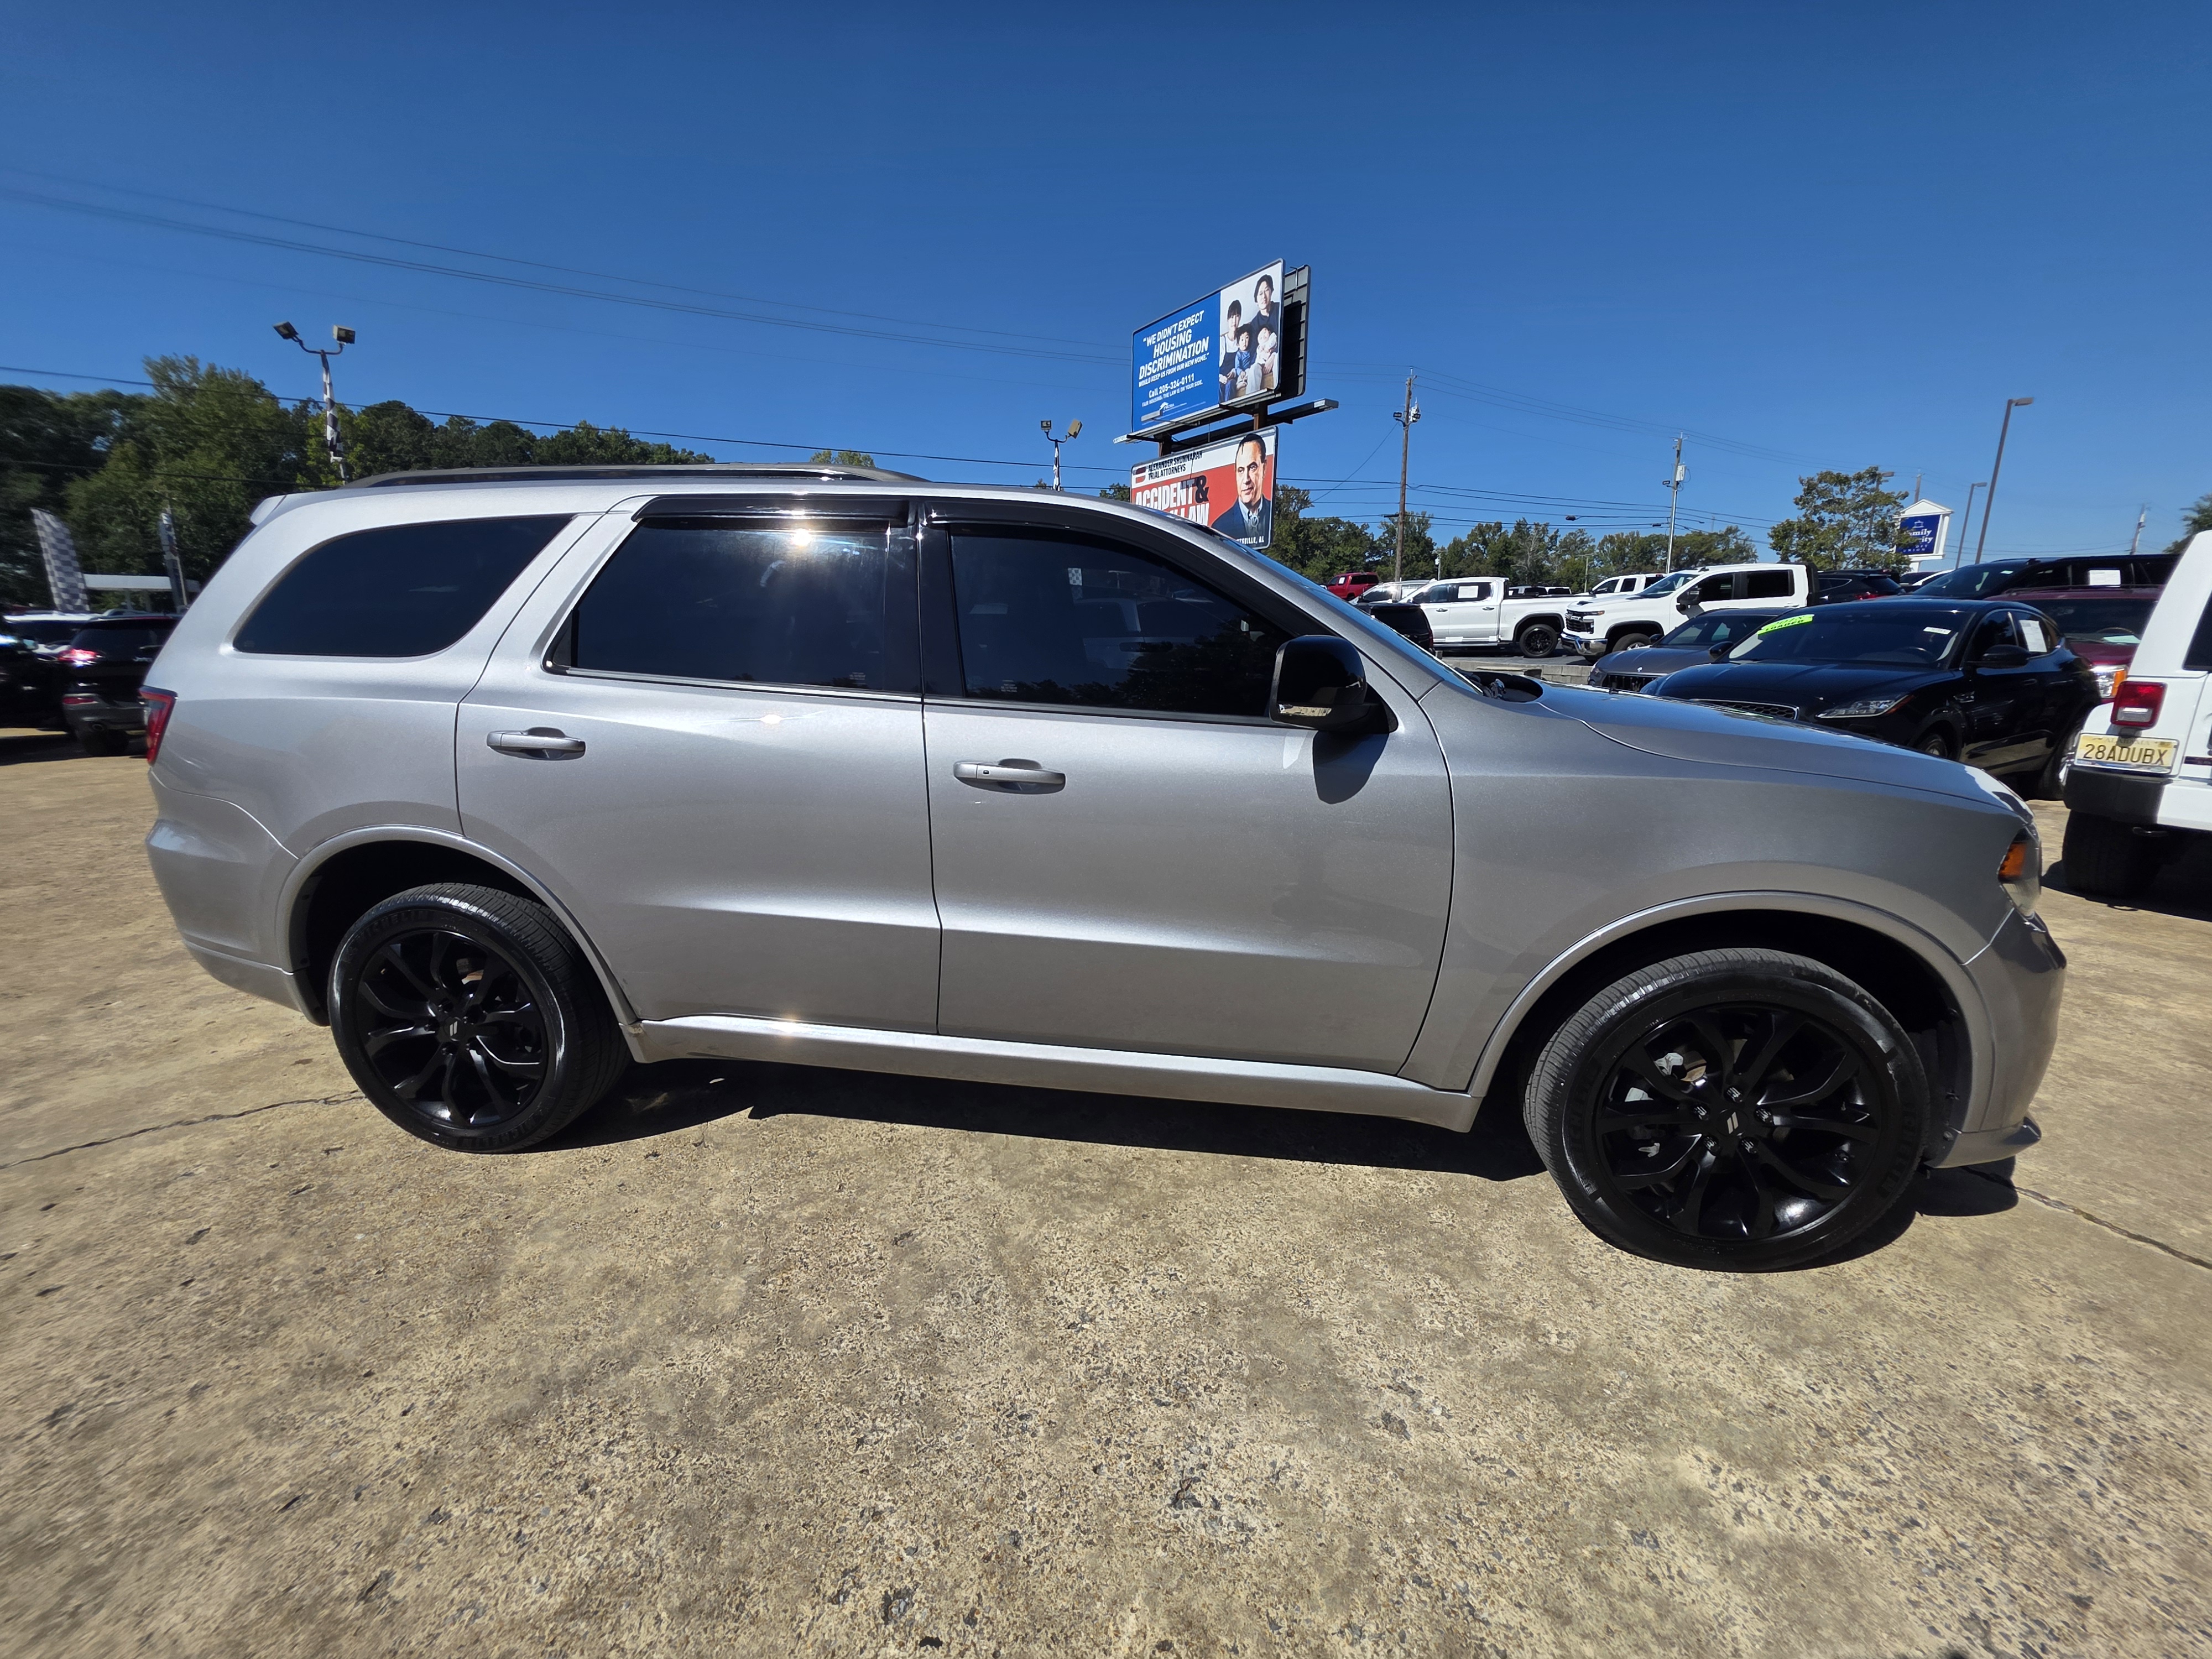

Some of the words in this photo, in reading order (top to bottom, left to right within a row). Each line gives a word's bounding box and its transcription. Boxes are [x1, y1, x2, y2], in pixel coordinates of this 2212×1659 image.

[1157, 323, 1178, 342] DIDN'T
[1178, 310, 1204, 332] EXPECT
[1153, 329, 1192, 358] HOUSING
[1139, 336, 1209, 380] DISCRIMINATION
[1139, 377, 1151, 387] WOULD
[1151, 373, 1161, 382] KEEP
[1166, 366, 1176, 375] FROM
[1185, 358, 1194, 368] NEW
[1149, 388, 1158, 398] Call
[1148, 459, 1173, 472] ALEXANDER
[1173, 450, 1203, 465] SHUNNARAH
[1148, 471, 1160, 481] TRIAL
[1160, 464, 1186, 477] ATTORNEYS
[1135, 478, 1195, 512] ACCIDENT
[1195, 475, 1209, 504] &
[1908, 528, 1932, 536] amily
[1766, 619, 1804, 631] LOADED
[2083, 743, 2168, 765] 28ADUBX
